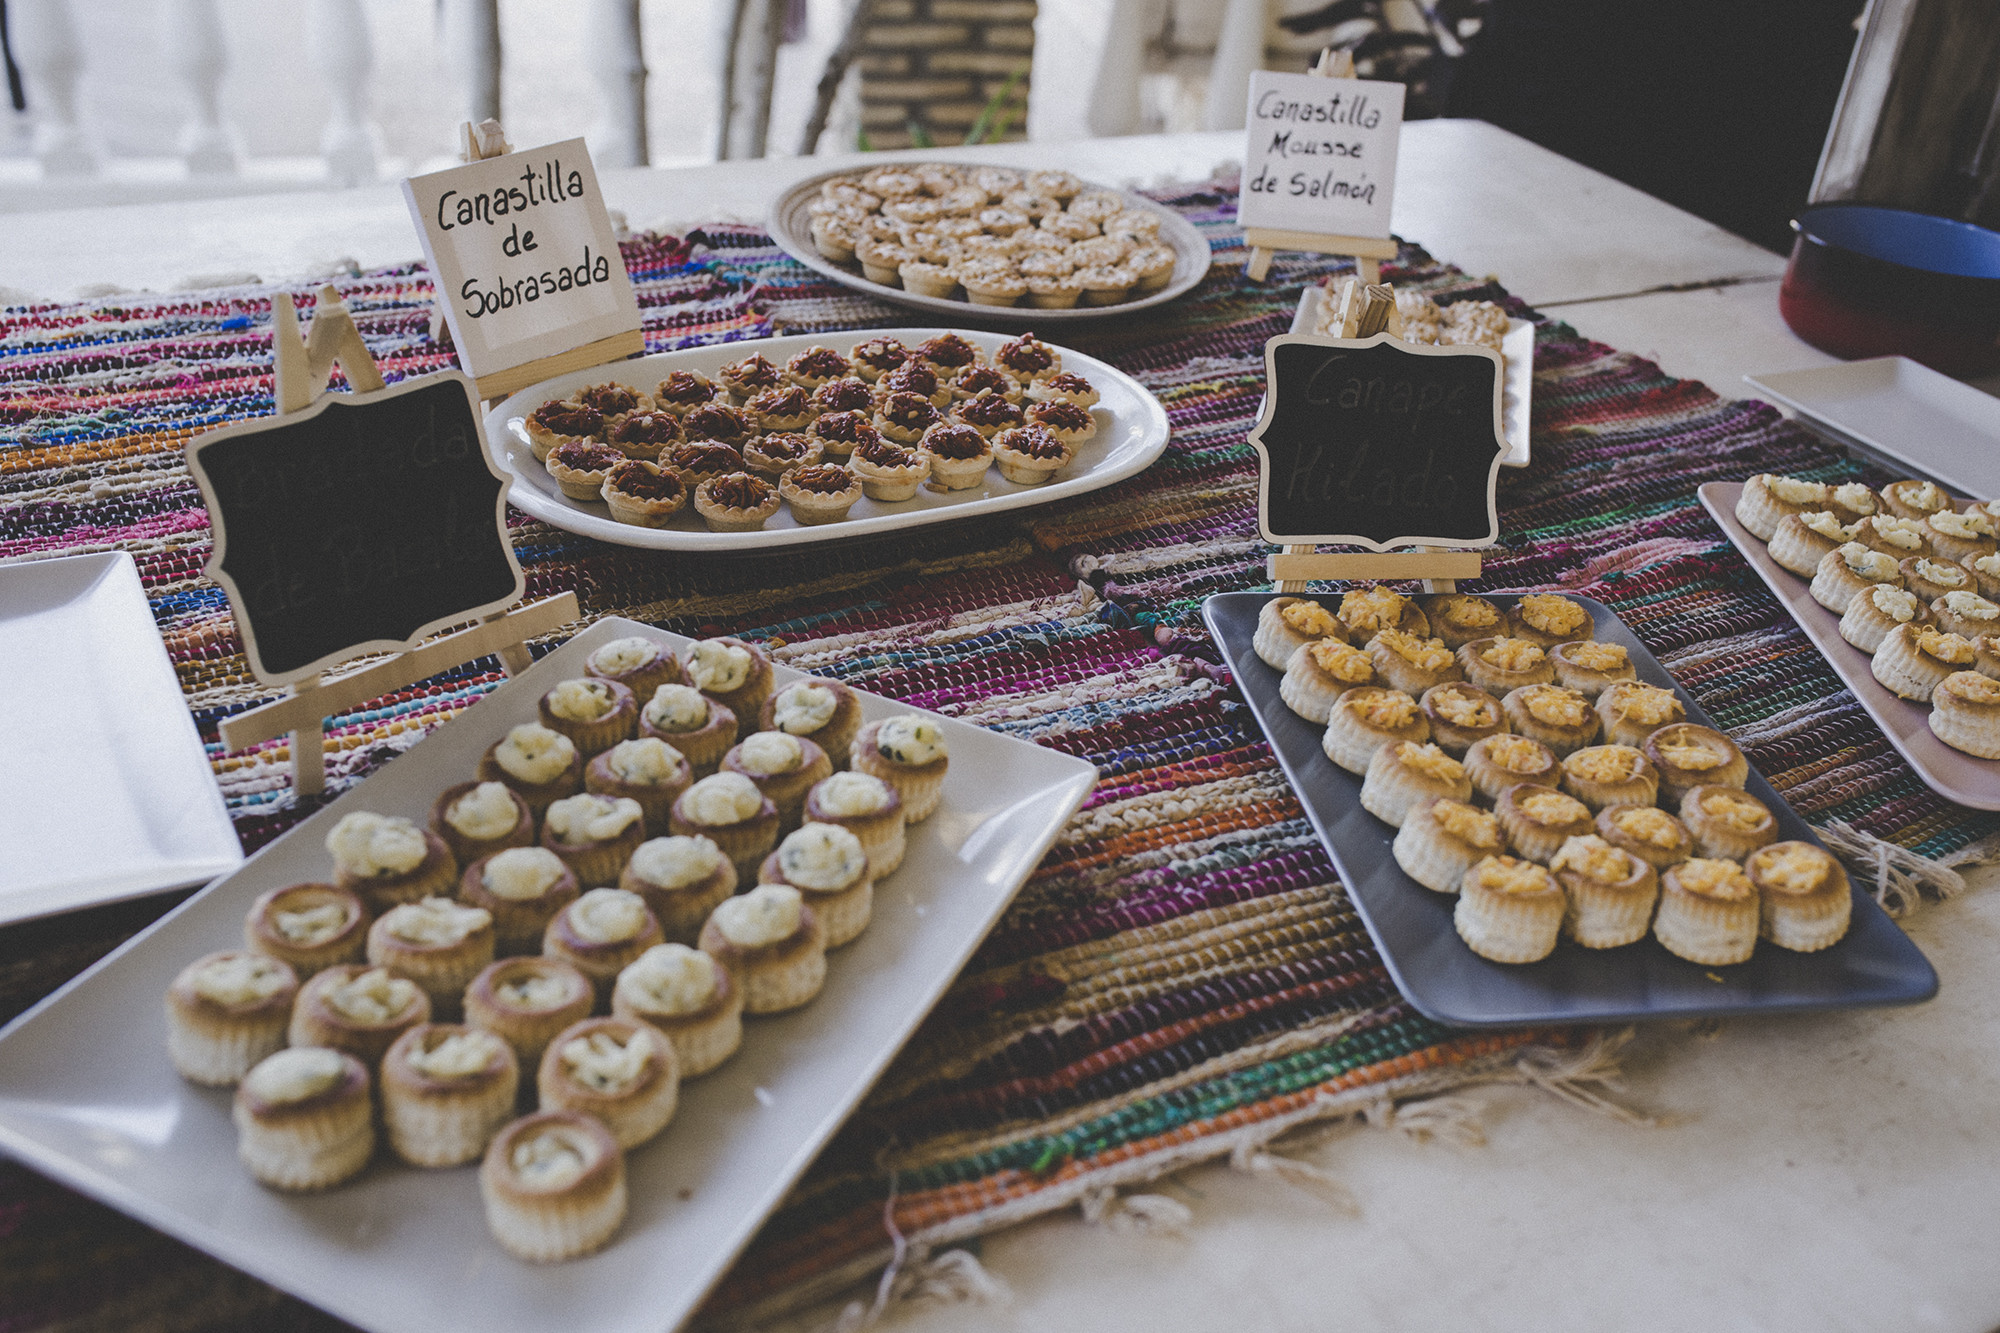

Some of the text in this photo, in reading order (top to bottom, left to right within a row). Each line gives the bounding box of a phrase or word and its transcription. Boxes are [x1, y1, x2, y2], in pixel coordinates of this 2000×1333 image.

[1255, 89, 1382, 130] Canastilla
[1267, 130, 1363, 159] Mousse
[437, 158, 584, 231] Canastilla
[1250, 164, 1278, 193] de
[502, 222, 539, 257] de
[461, 245, 610, 318] Sobrasada
